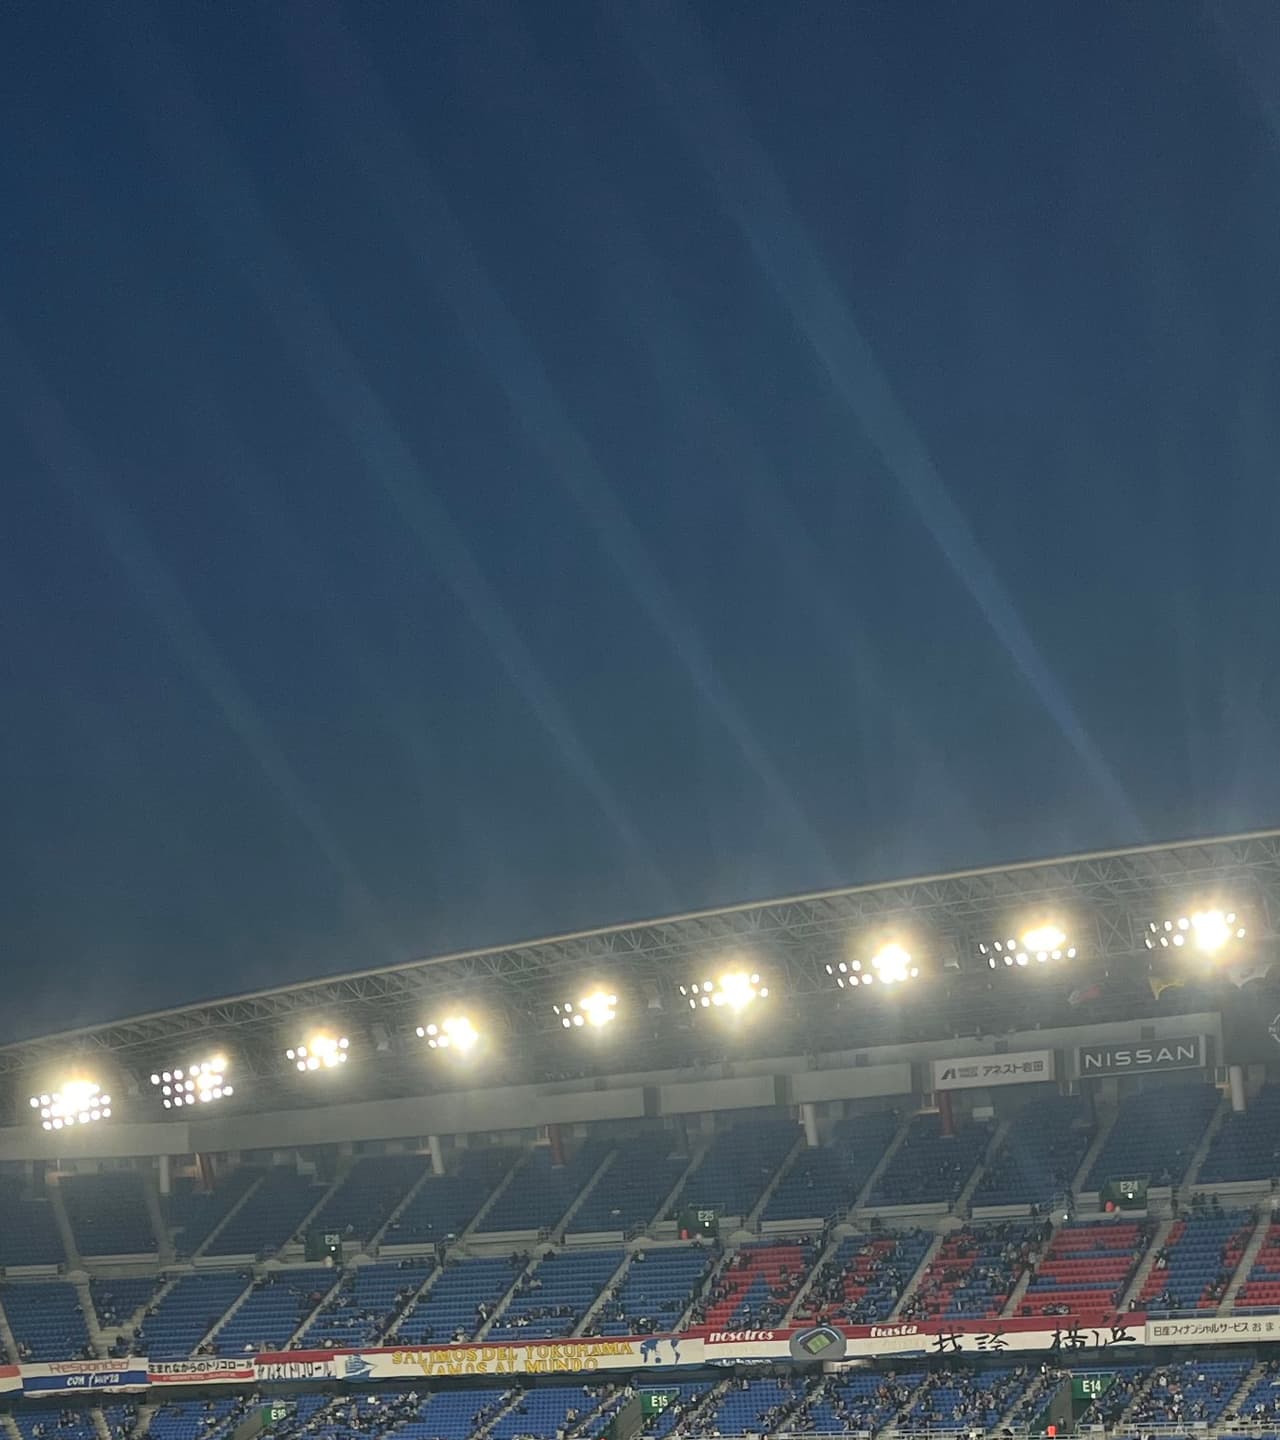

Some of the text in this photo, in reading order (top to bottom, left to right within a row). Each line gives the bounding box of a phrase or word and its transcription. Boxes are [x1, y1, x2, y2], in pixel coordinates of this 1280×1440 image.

[1085, 1044, 1194, 1069] NISSAN
[709, 1329, 774, 1343] nosotros
[1154, 1322, 1248, 1337] 日産フィナンシャルサービス
[1082, 1380, 1101, 1392] E14
[651, 1395, 668, 1407] E15
